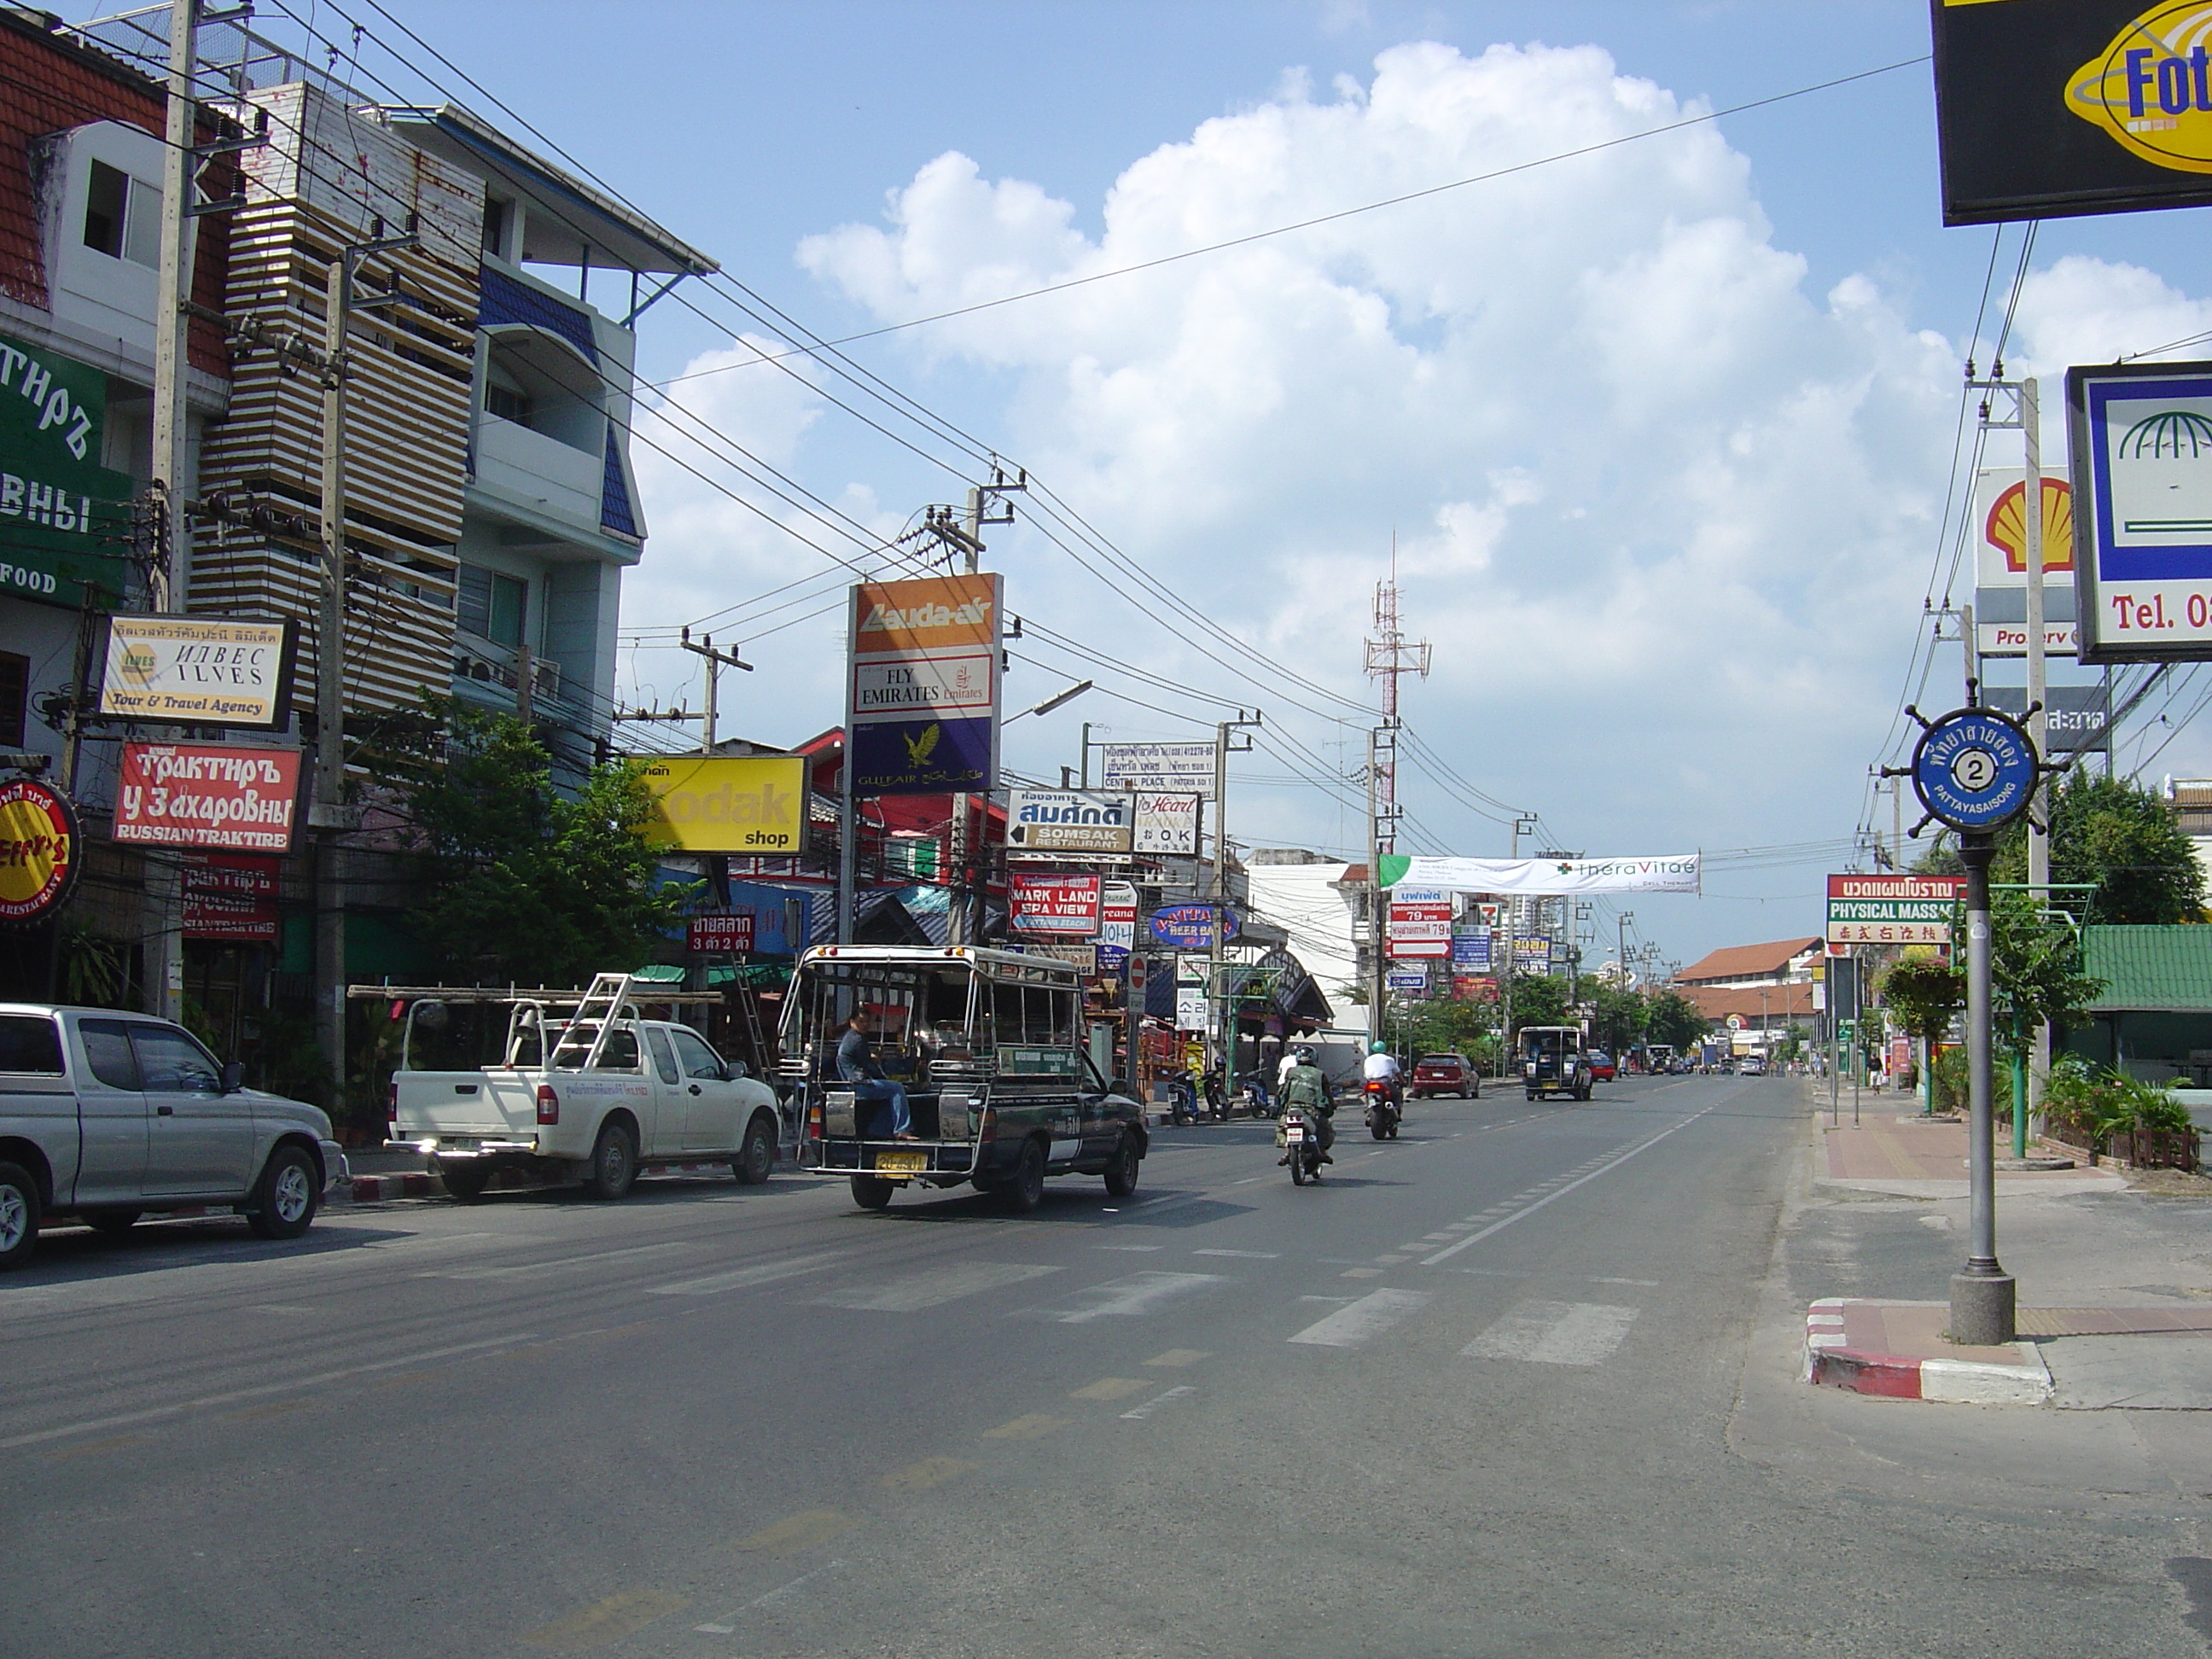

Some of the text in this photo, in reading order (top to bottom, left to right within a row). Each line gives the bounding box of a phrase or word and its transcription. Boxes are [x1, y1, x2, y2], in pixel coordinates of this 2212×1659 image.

[0, 562, 56, 594] FOOD
[2112, 593, 2212, 629] Tel. 0
[178, 664, 263, 685] ILVES
[888, 668, 915, 684] FLY
[862, 686, 939, 705] EMIRATES
[944, 689, 982, 700] Emirates
[113, 693, 263, 715] Tour & Travel Agency
[1968, 760, 1983, 781] 2
[1141, 777, 1165, 787] PLACE
[1934, 782, 2017, 814] PATTAYASAISONG
[1019, 798, 1126, 825] สมศักดิ์
[117, 824, 288, 848] RUSSIAN TRAKTIRE
[745, 830, 789, 848] shop
[1038, 828, 1118, 841] SOMSAK
[1035, 838, 1120, 848] RESTAURANT
[1578, 860, 1696, 876] TheraVitae
[6, 873, 61, 916] RESTAURANT
[1843, 877, 1953, 897] นวดแผนโบราณ
[1013, 888, 1051, 902] MARK
[1058, 890, 1097, 903] LAND
[1022, 903, 1088, 915] SPA VIEW
[1406, 911, 1423, 921] 79
[1831, 903, 1897, 919] PHYSICAL
[1060, 918, 1086, 927] BEACH
[1199, 925, 1214, 936] BA
[1433, 923, 1446, 936] 79
[694, 935, 749, 950] 3 ตัว 2 ตัว
